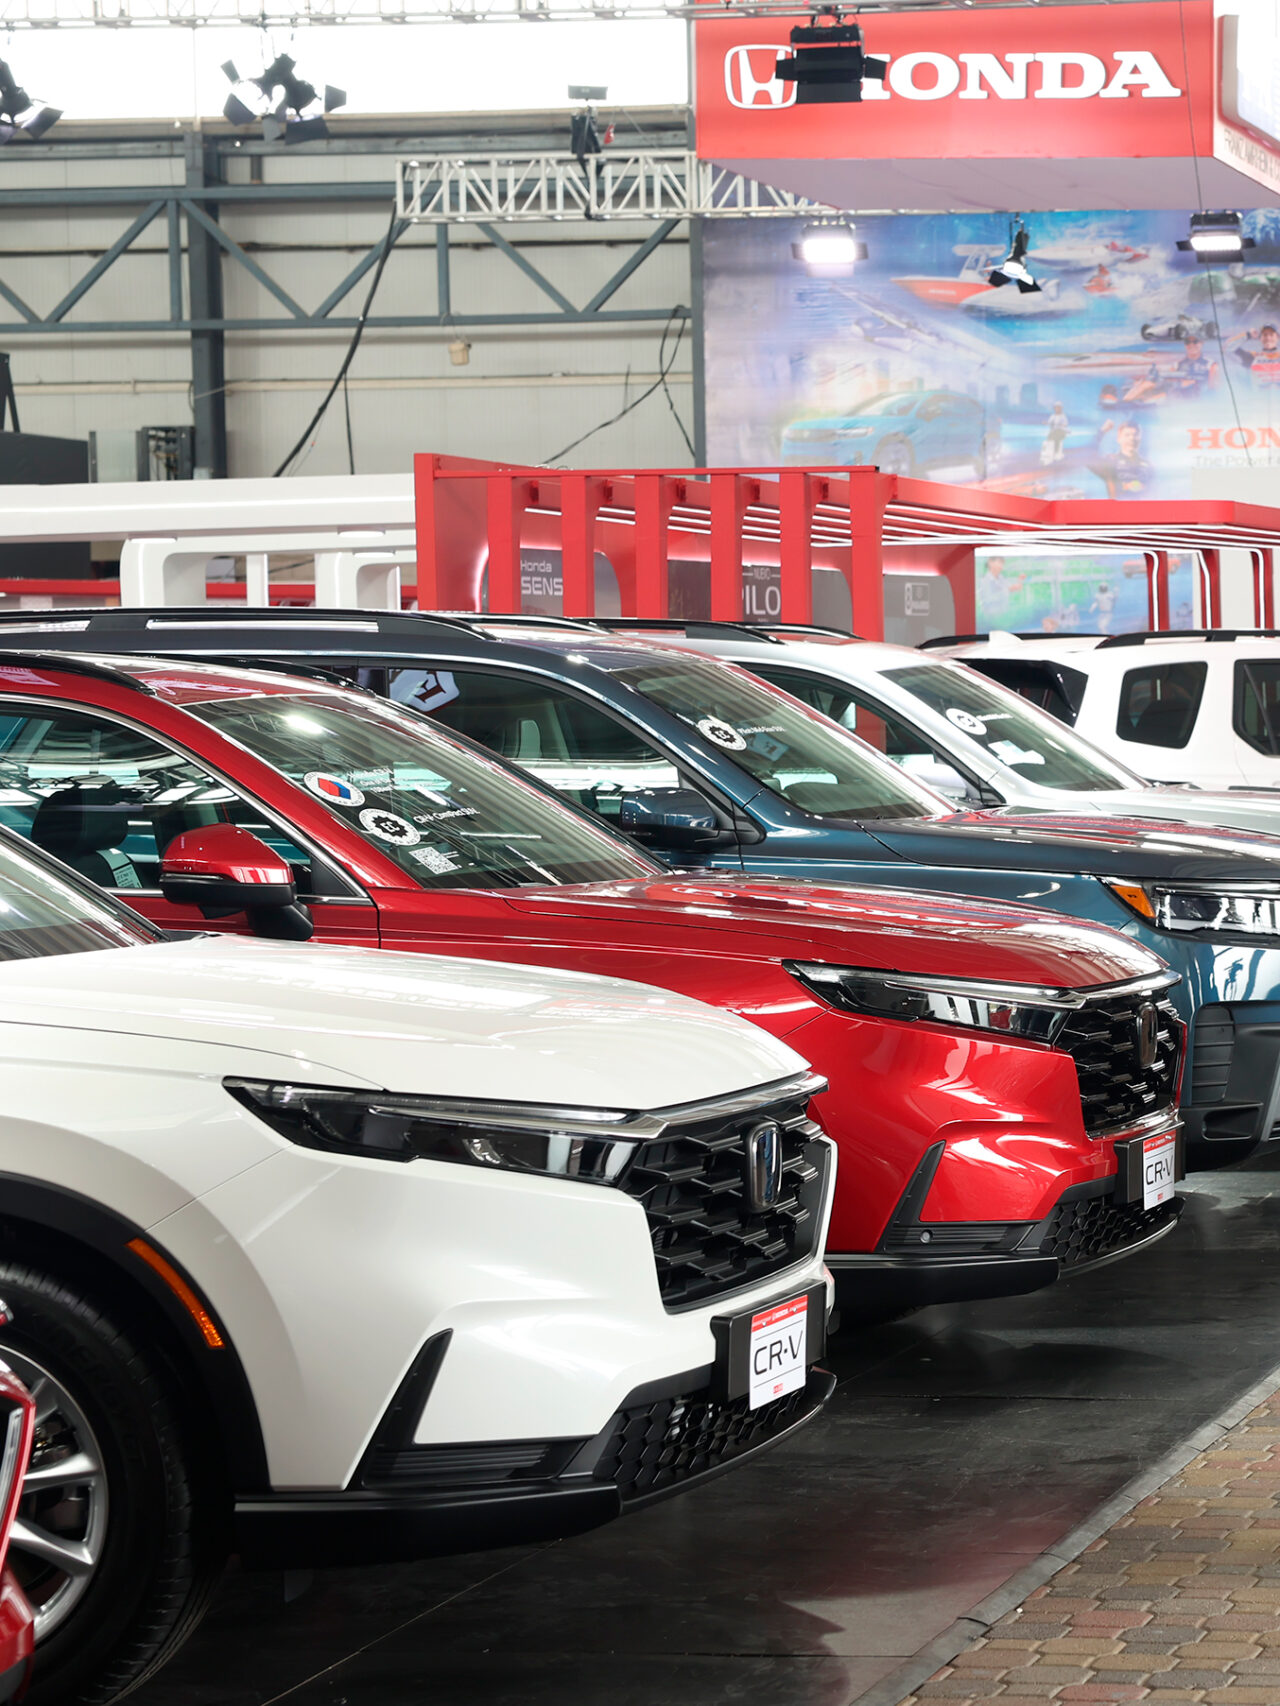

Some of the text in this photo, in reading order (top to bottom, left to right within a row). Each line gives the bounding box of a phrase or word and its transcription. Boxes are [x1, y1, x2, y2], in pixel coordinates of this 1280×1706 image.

[1195, 456, 1222, 467] The
[520, 560, 552, 573] Honda
[521, 576, 563, 596] SENS
[742, 585, 781, 615] ILO
[380, 821, 400, 834] EC
